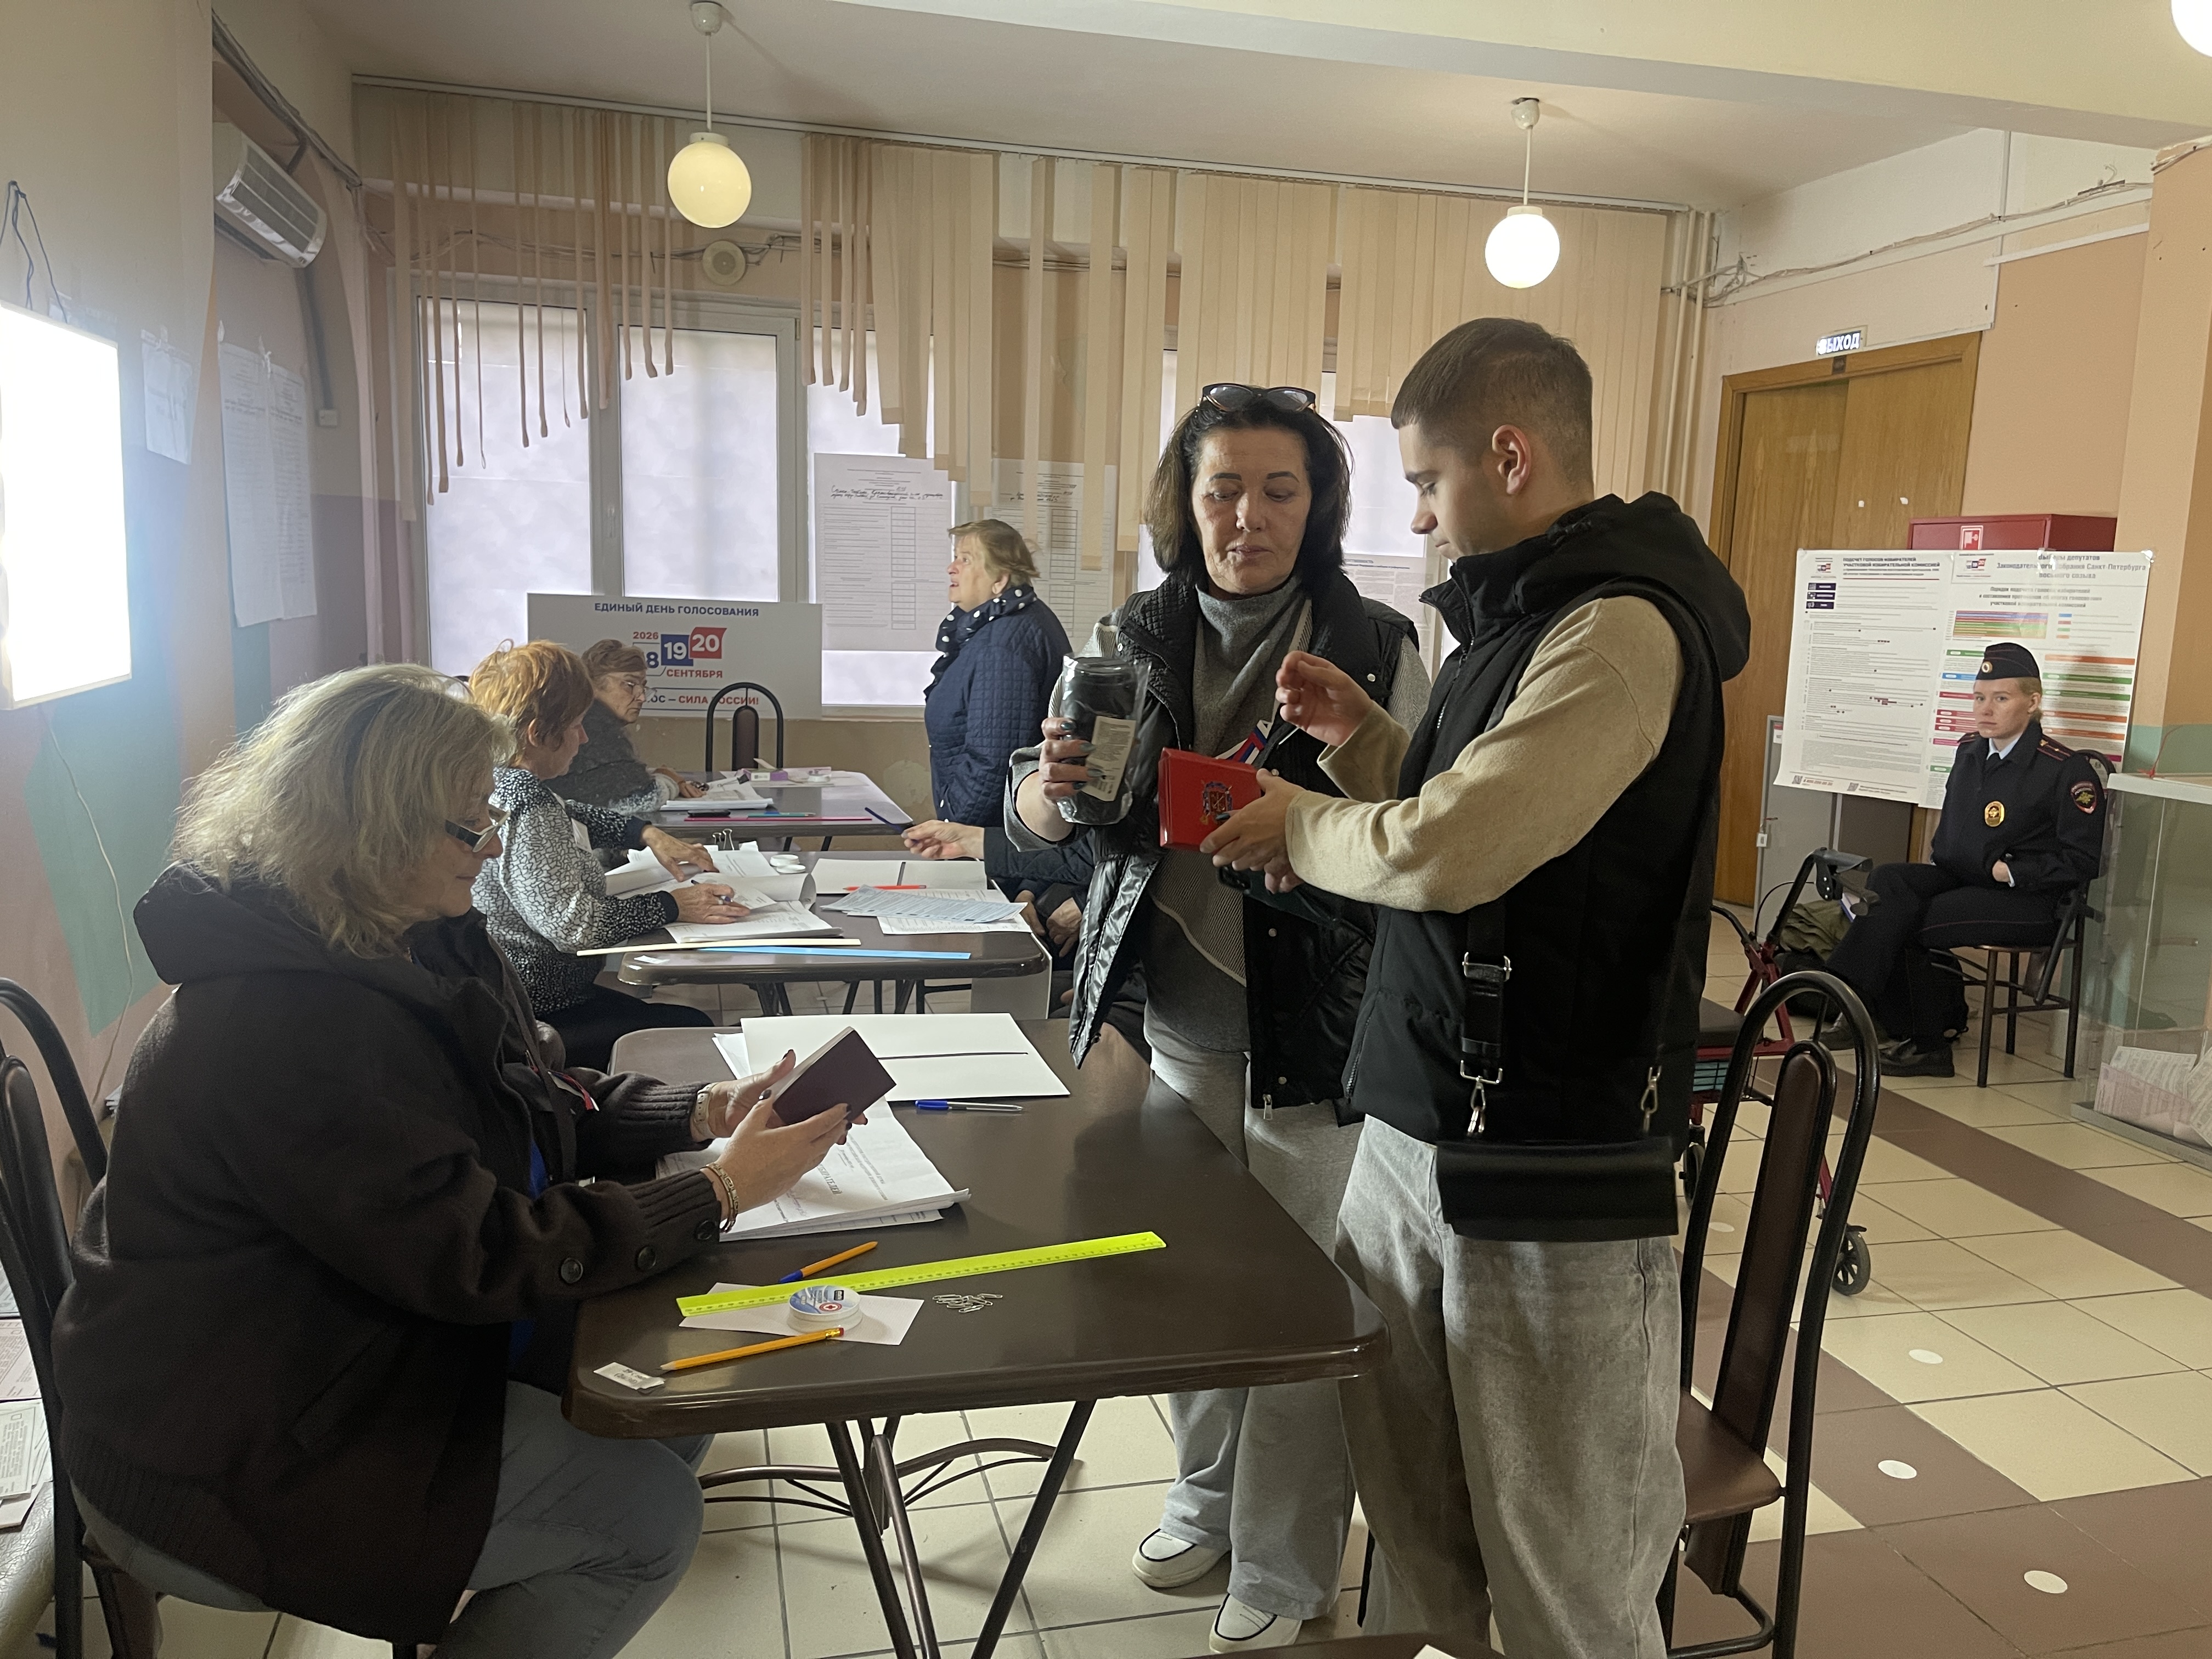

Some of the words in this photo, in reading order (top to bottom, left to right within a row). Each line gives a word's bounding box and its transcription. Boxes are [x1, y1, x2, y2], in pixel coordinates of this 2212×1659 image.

[595, 602, 642, 612] ЕДИНЫЙ
[646, 605, 675, 614] ДЕНЬ
[678, 606, 759, 616] ГОЛОСОВАНИЯ
[633, 631, 658, 640] 2026
[664, 642, 687, 660] 19
[692, 634, 720, 652] 20
[666, 669, 723, 678] СЕНТЯБРЯ
[679, 695, 708, 704] СИЛА
[712, 696, 759, 705] ОССИИ!
